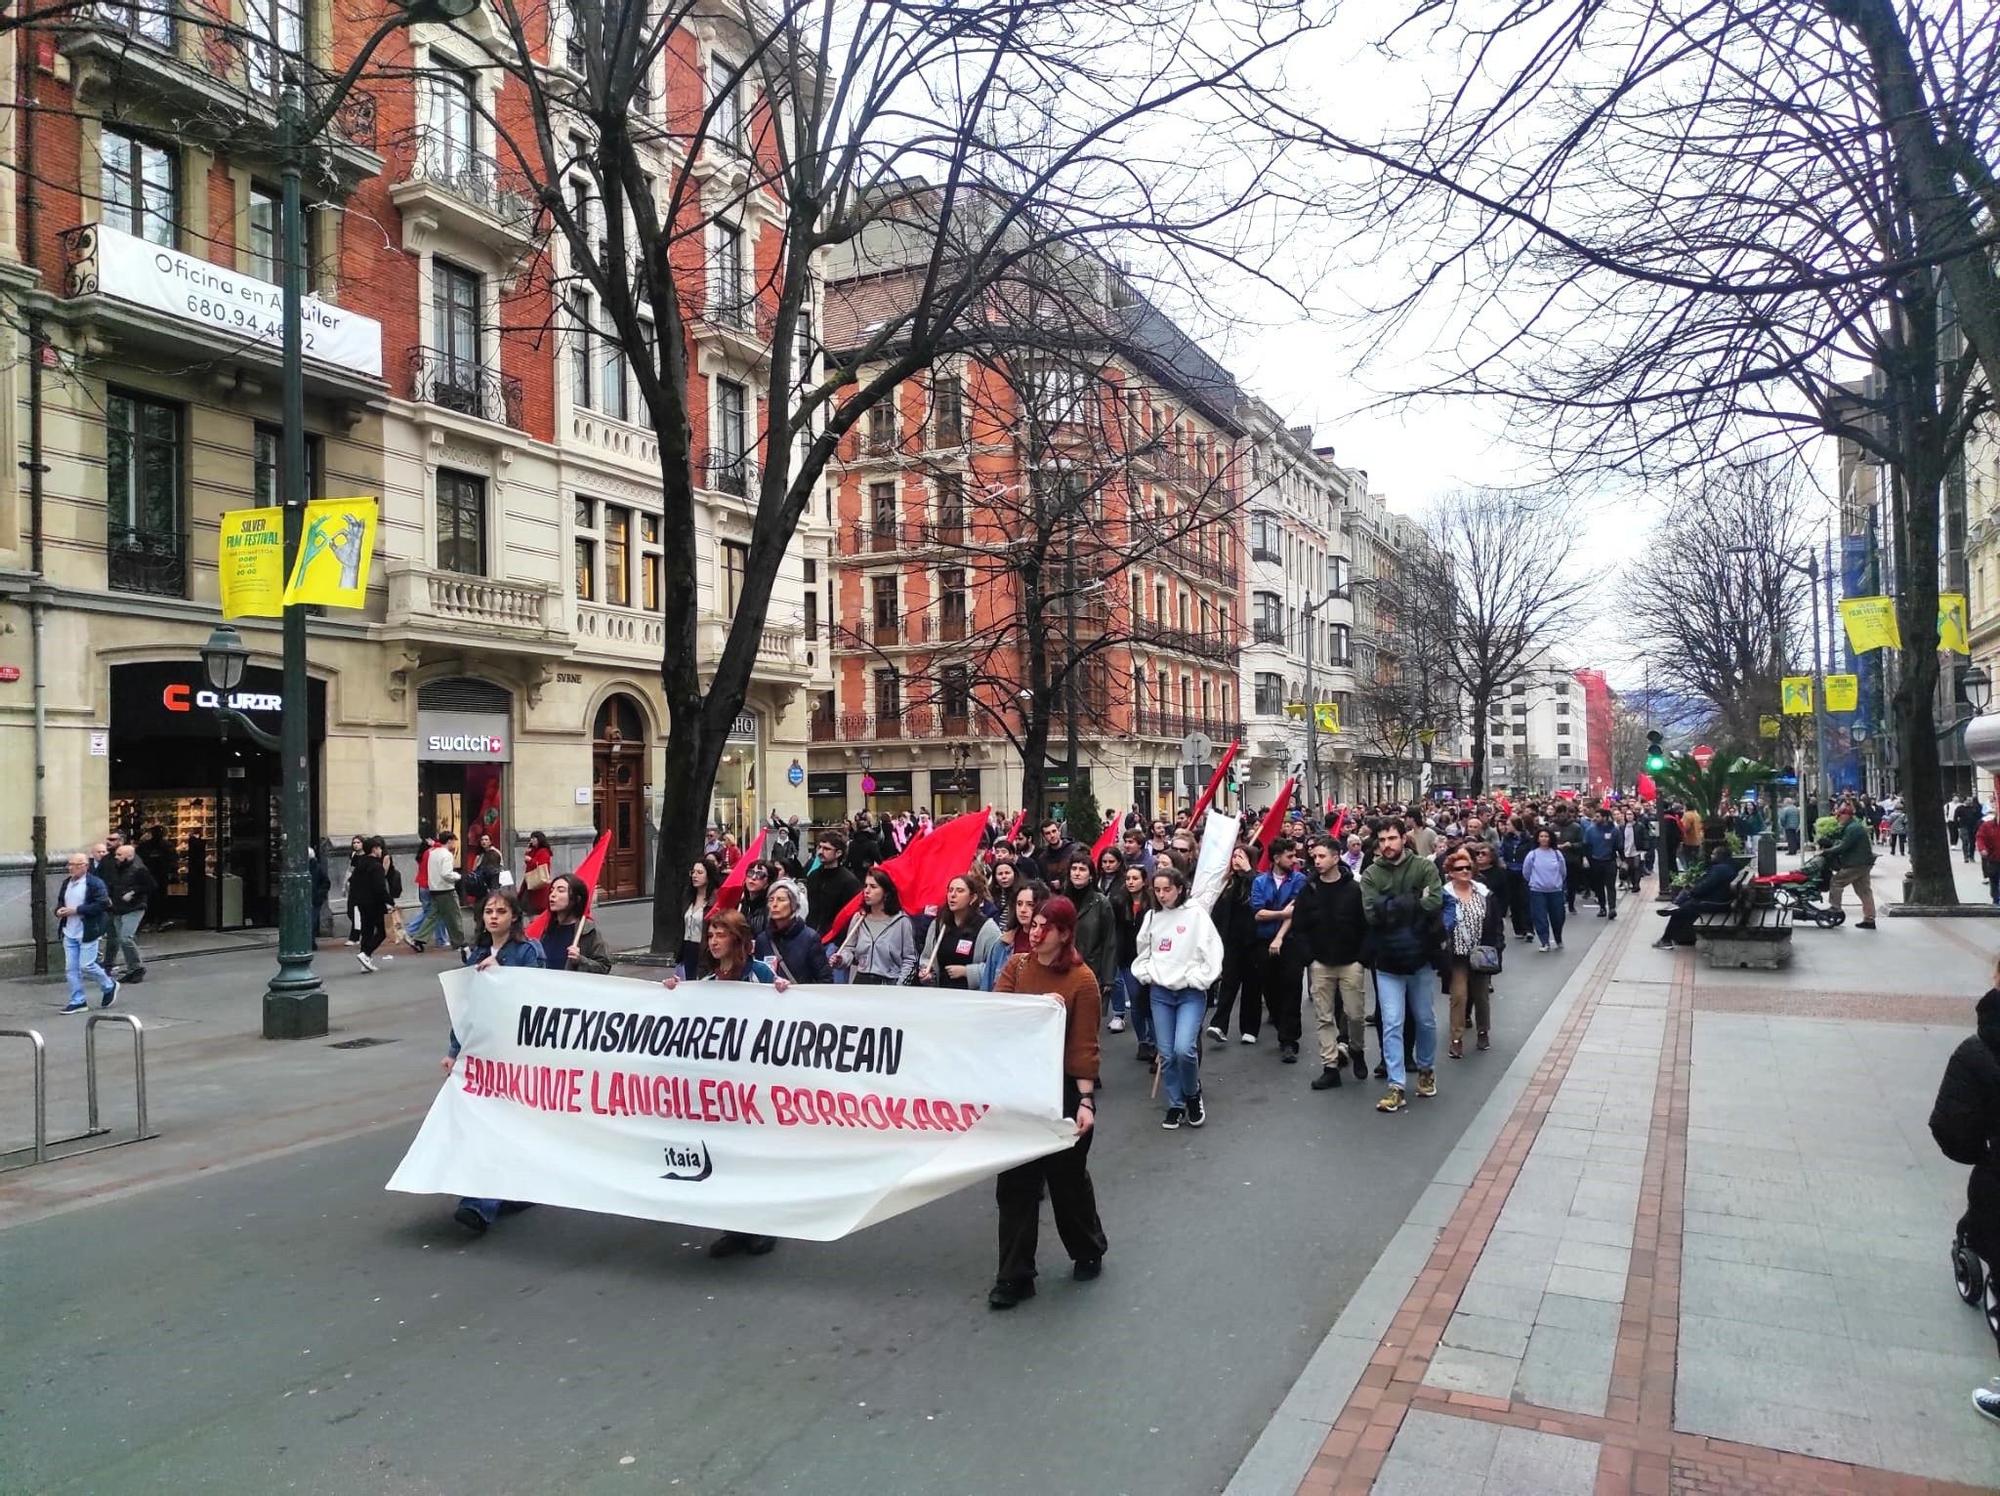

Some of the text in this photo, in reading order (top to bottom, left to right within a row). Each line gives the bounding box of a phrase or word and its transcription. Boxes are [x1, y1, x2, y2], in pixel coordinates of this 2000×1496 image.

[155, 253, 341, 330] Oficina en Auiler
[240, 518, 267, 533] SILVER
[226, 531, 280, 548] FILM FESTIVAL
[429, 734, 491, 751] swatch
[517, 1004, 904, 1076] MATXISMOAREN AURREAN
[462, 1055, 584, 1113] EMAKUME
[591, 1070, 765, 1125] LANGILEOK
[664, 1147, 702, 1169] itaia
